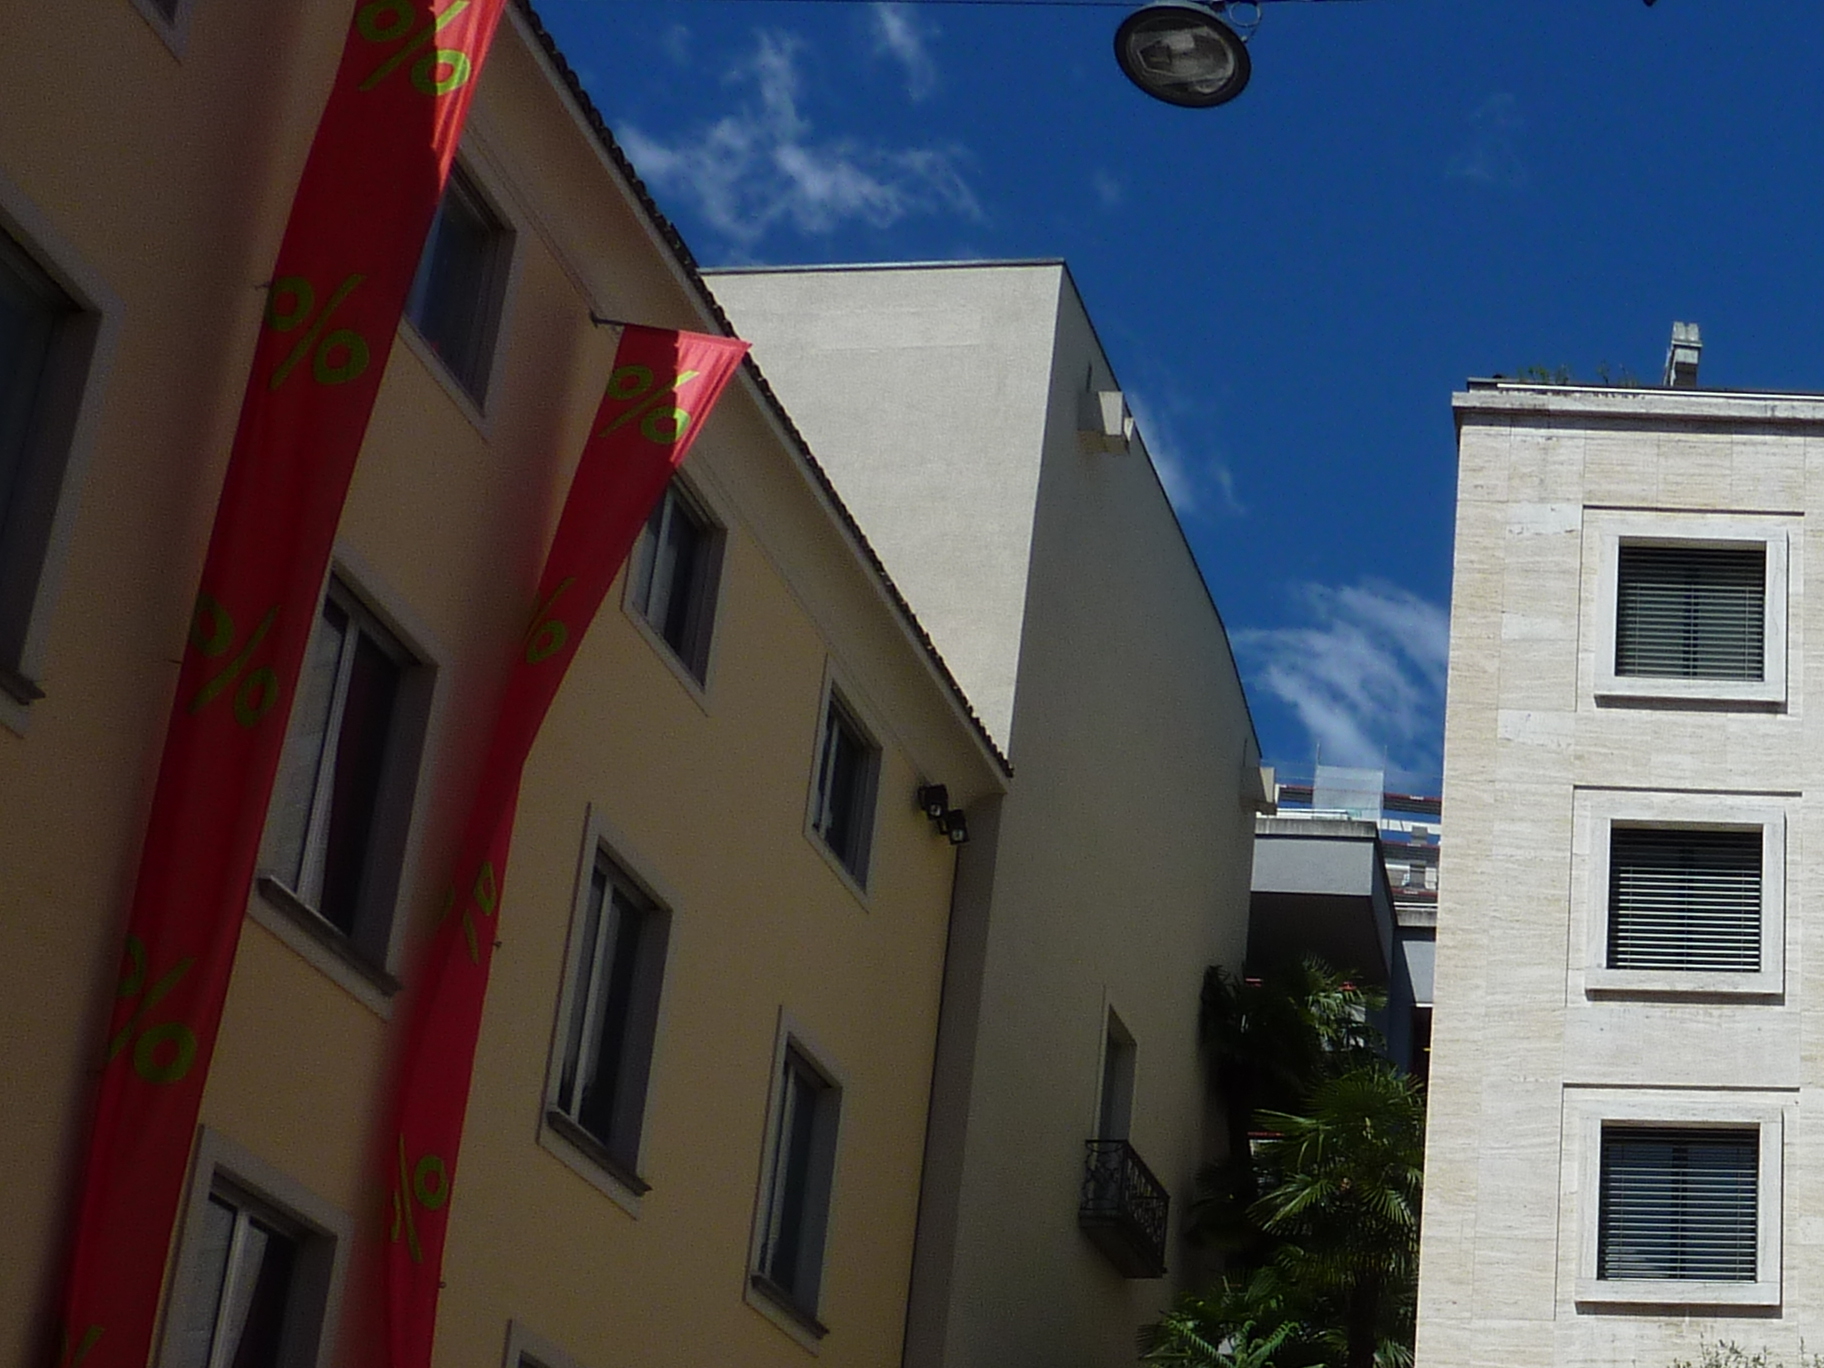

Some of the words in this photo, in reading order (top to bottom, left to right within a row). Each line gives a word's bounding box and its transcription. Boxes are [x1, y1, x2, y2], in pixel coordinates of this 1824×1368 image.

[357, 0, 471, 96] %
[266, 273, 370, 390] %
[606, 364, 700, 444] %
